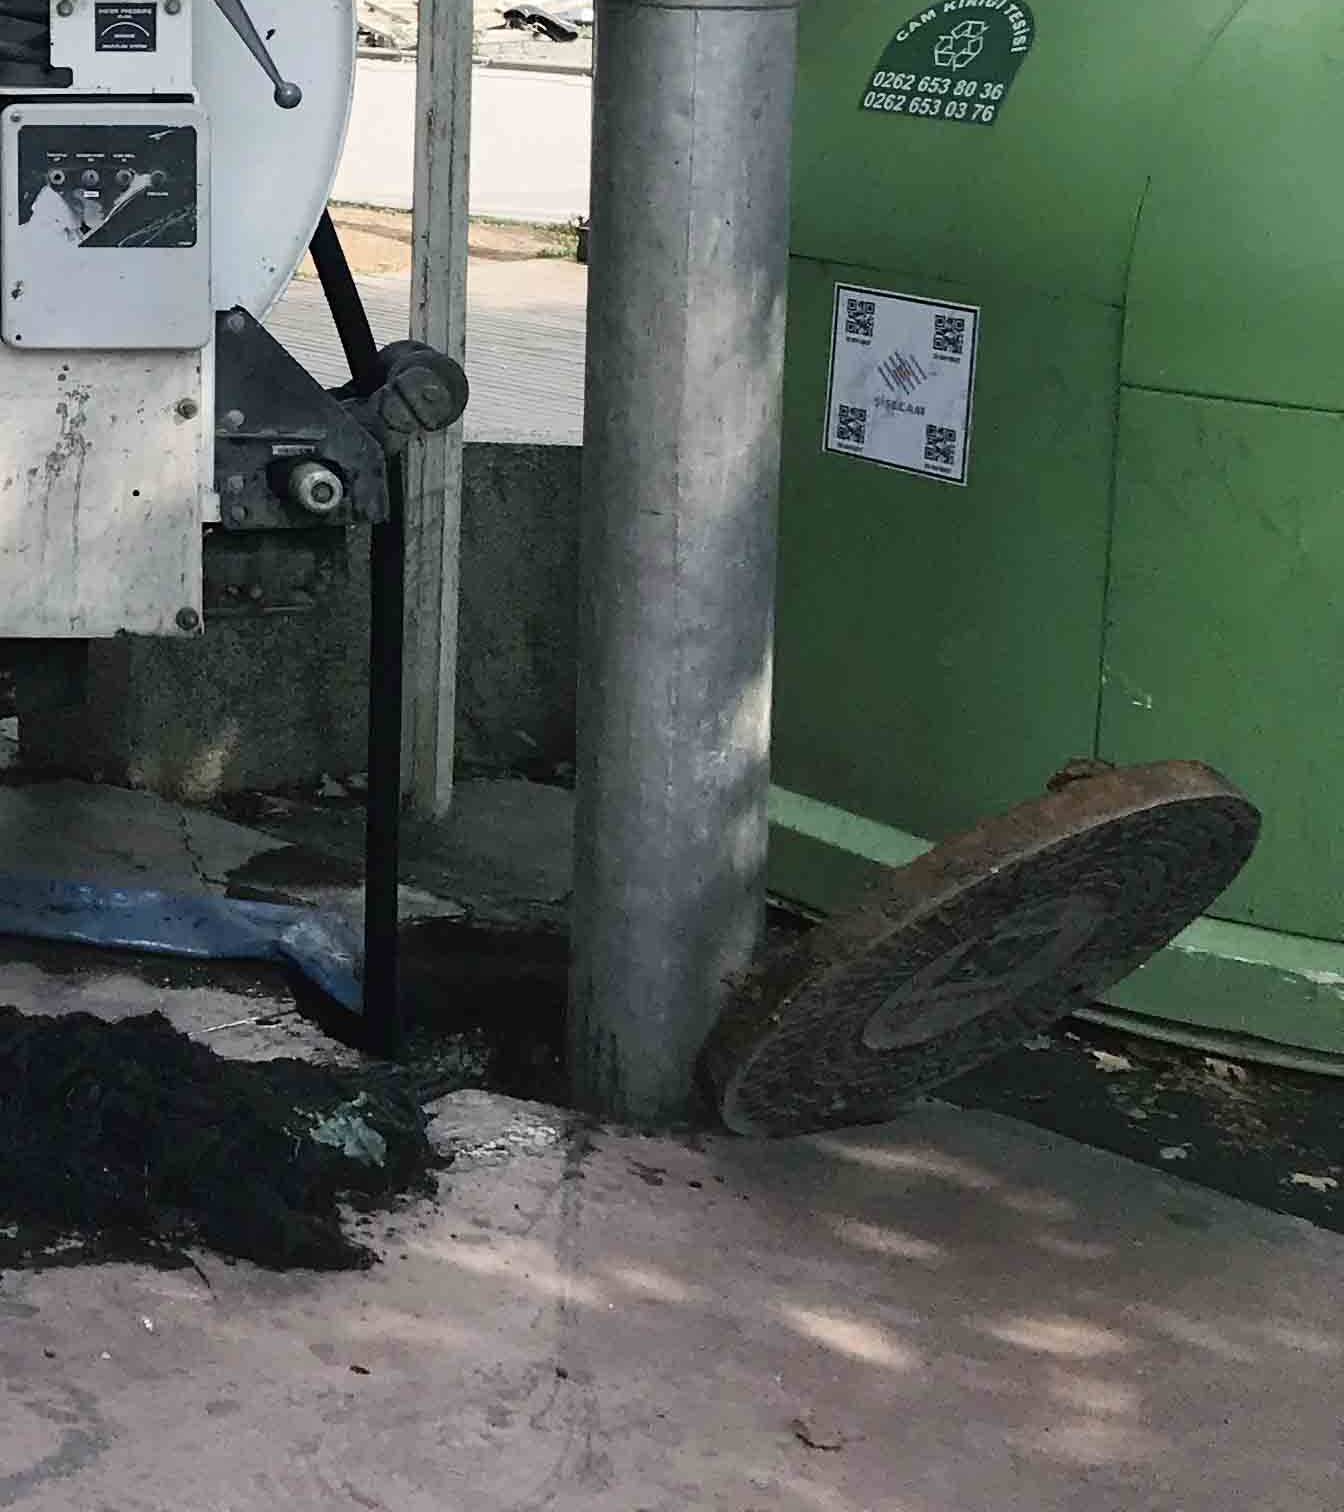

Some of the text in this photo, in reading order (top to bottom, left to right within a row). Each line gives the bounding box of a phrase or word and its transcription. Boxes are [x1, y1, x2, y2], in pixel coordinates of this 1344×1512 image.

[896, 9, 937, 41] CAM
[872, 71, 1004, 100] 0262 653 80 36
[863, 91, 995, 122] 0262 653 03 76
